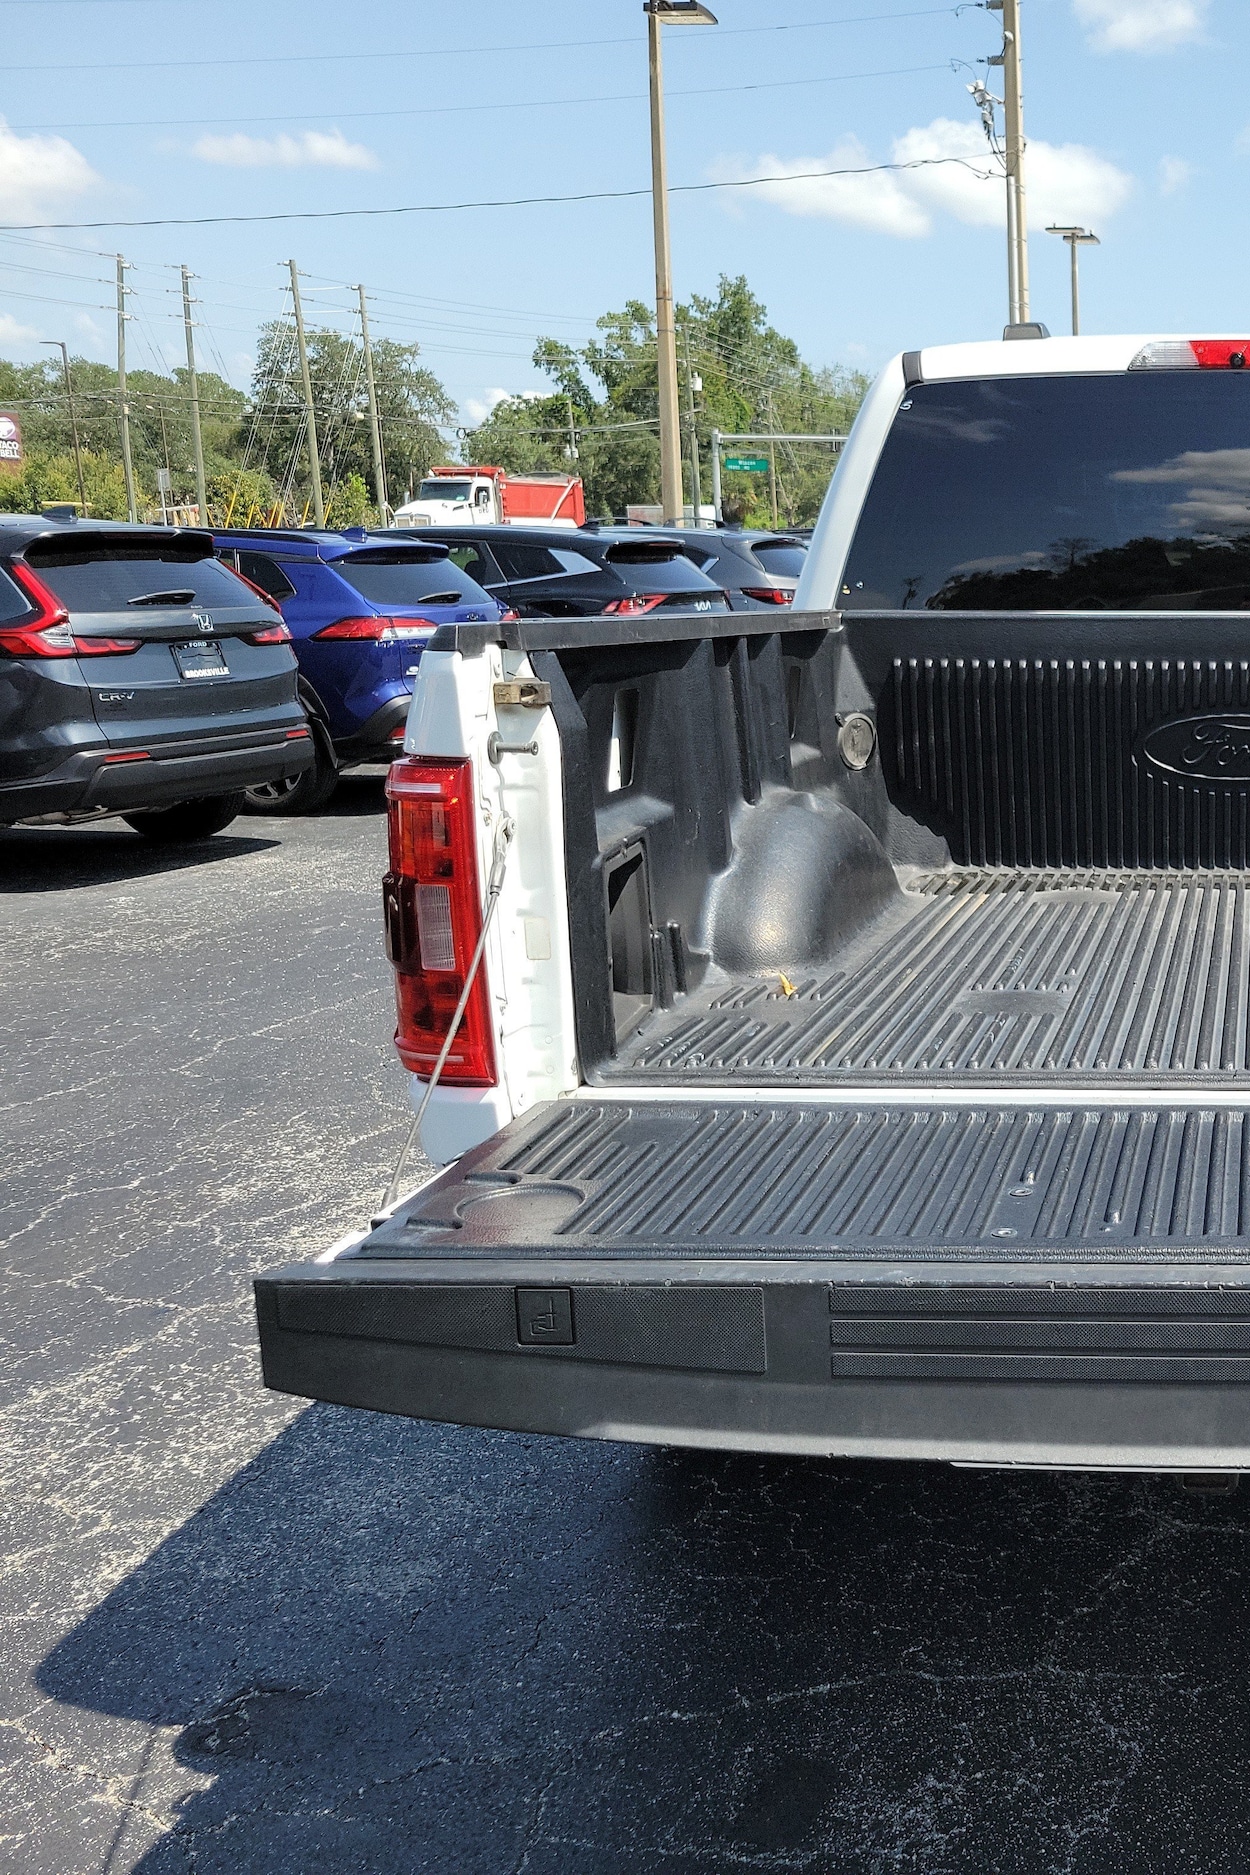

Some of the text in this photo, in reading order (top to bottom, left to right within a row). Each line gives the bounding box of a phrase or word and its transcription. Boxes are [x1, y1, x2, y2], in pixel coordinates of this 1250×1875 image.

[0, 449, 20, 458] BELL
[184, 666, 230, 679] BROOKSVILLE
[98, 691, 135, 702] CR-V
